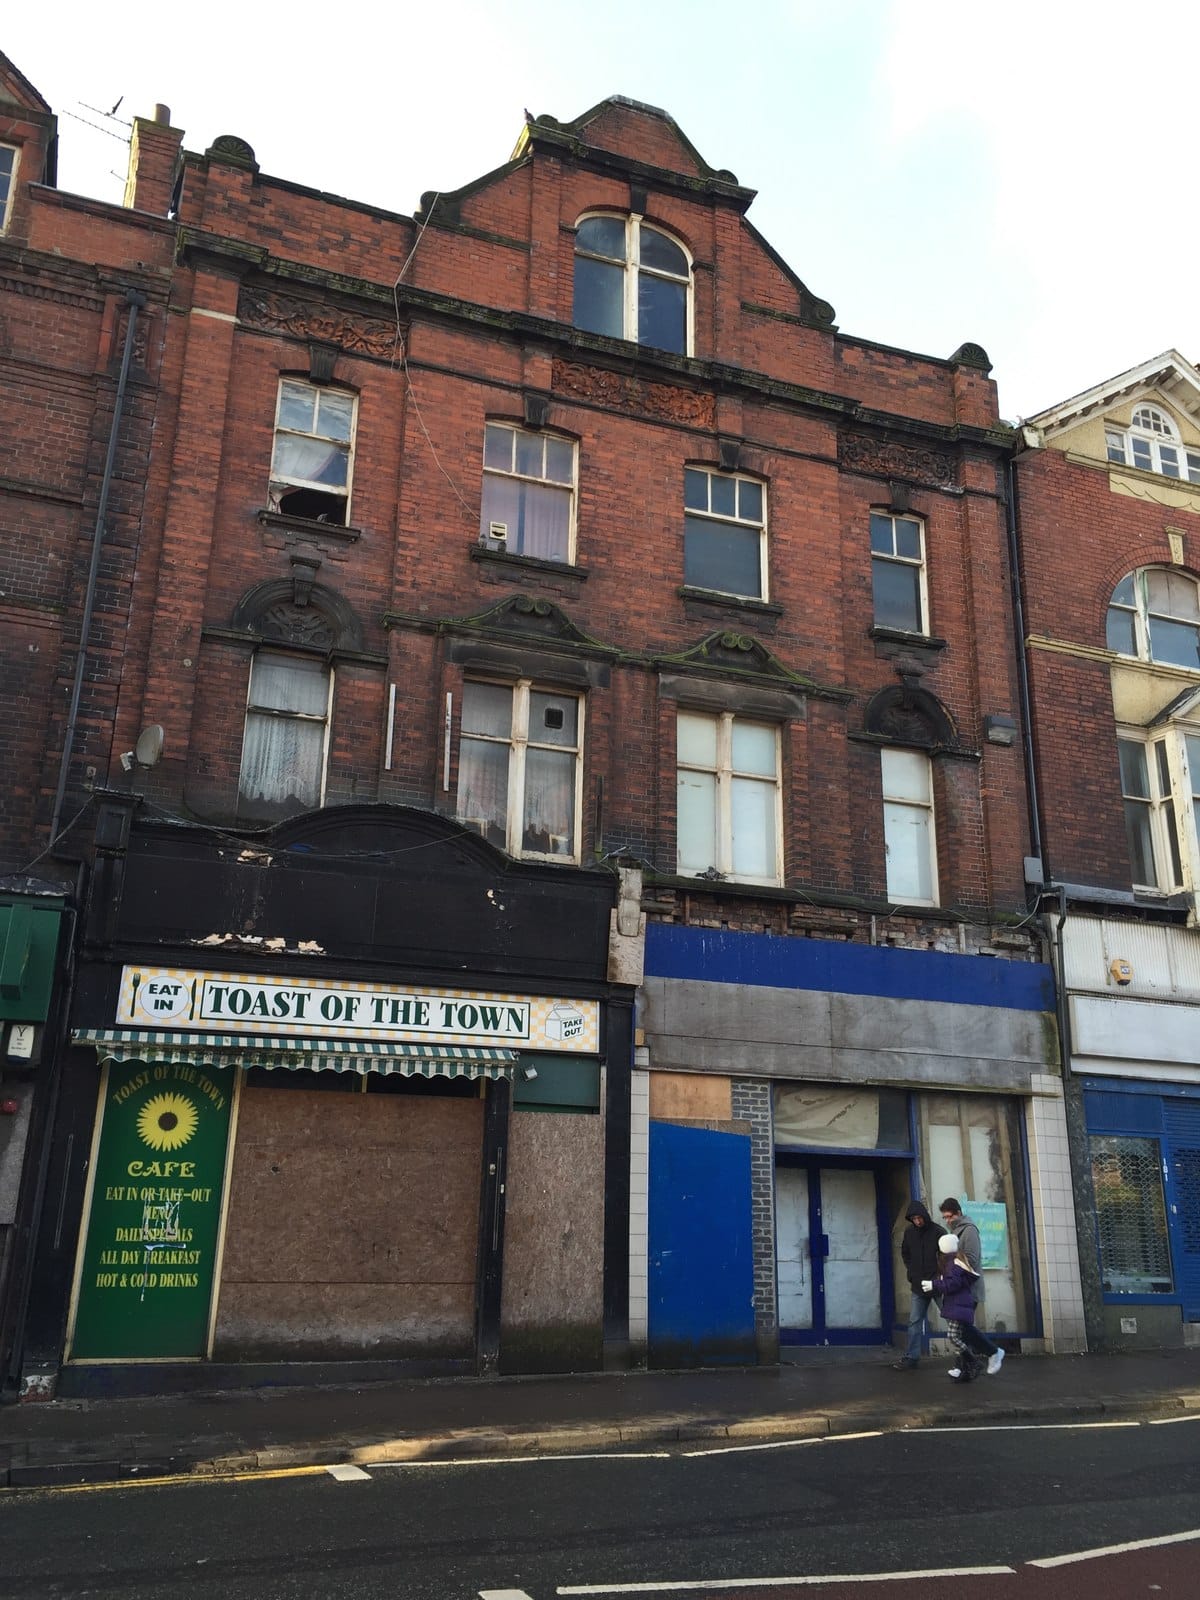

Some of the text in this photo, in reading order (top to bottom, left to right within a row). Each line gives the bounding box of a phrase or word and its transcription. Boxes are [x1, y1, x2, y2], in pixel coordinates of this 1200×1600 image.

[149, 984, 182, 996] EAT
[154, 999, 173, 1011] IN
[208, 985, 525, 1033] TOAST OF THE TOWN
[563, 1018, 583, 1028] TAKE
[564, 1027, 582, 1037] OUT
[113, 1065, 226, 1111] TOAST OF THE TOWN
[127, 1161, 196, 1177] CAFE
[105, 1187, 125, 1200] EAT
[126, 1187, 139, 1200] IN
[141, 1187, 156, 1200] OR
[100, 1251, 118, 1264] ALL
[120, 1251, 141, 1264] DAY
[96, 1274, 119, 1287] HOT
[120, 1274, 129, 1287] &
[159, 1274, 199, 1287] DRINKS
